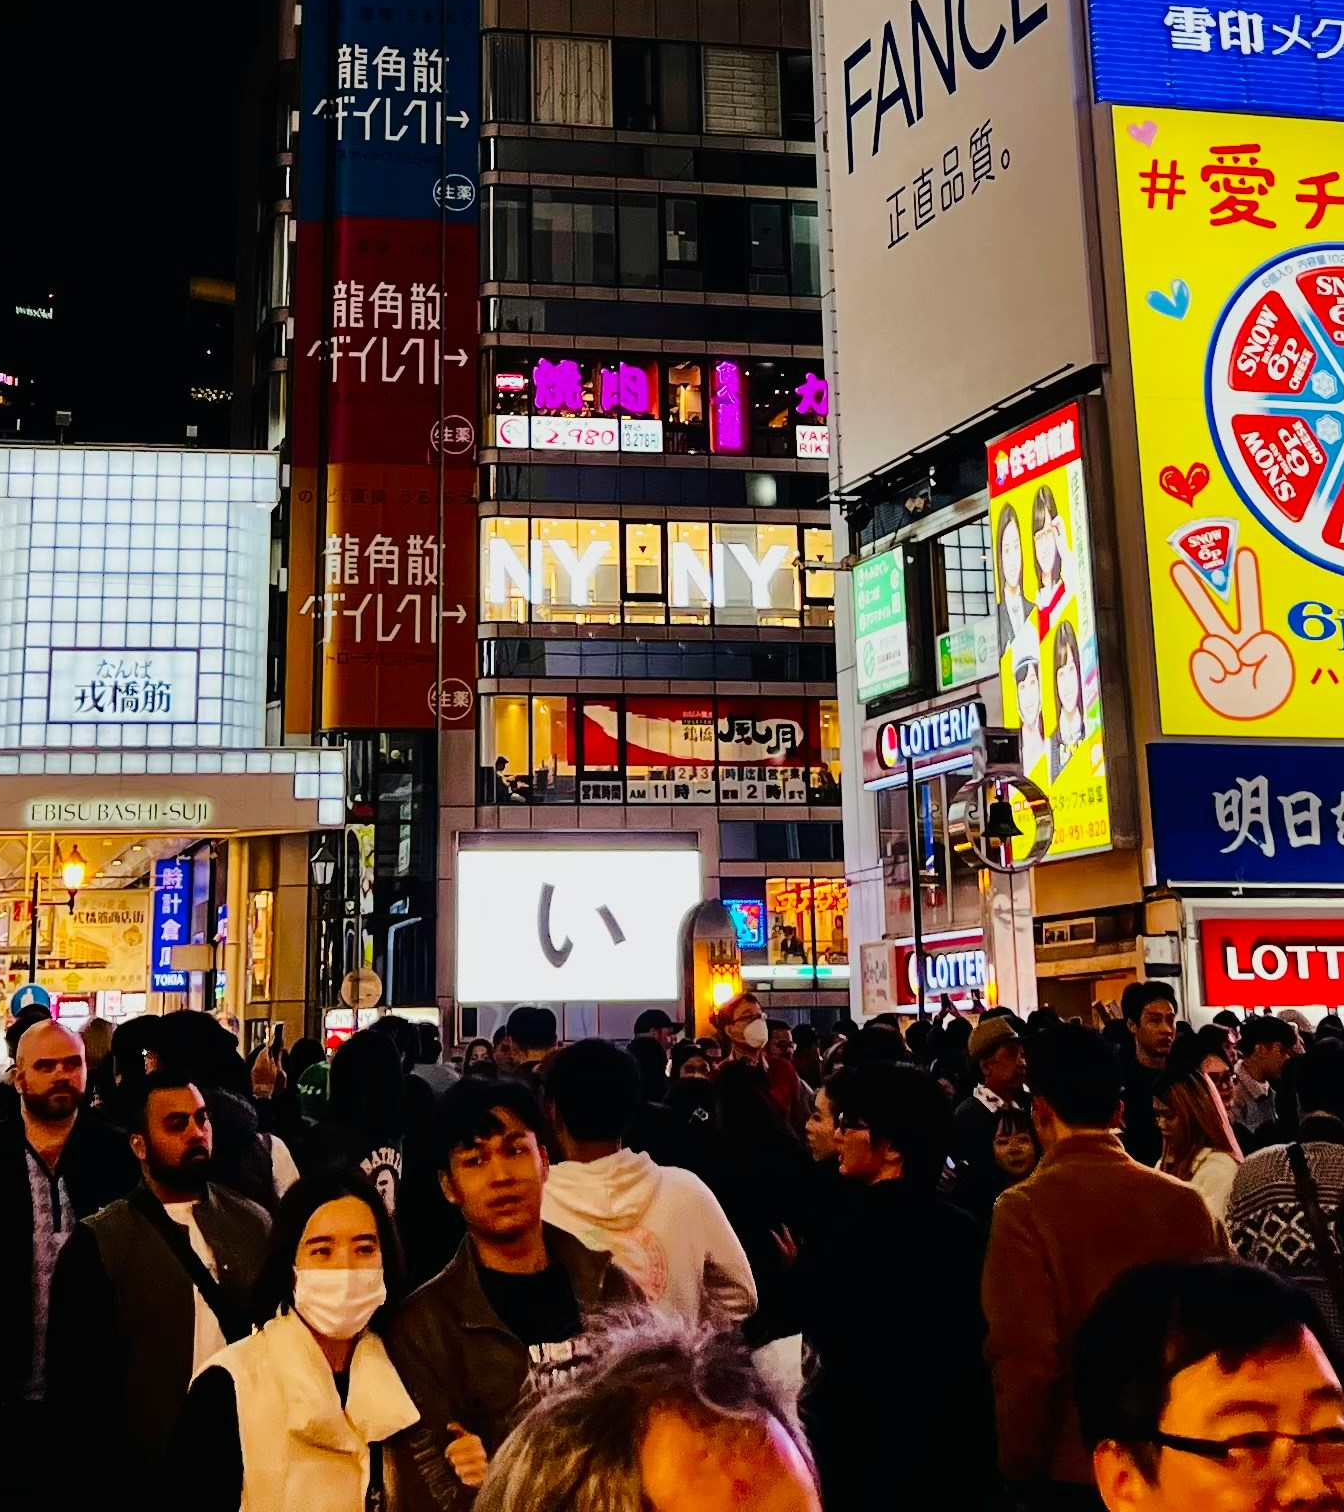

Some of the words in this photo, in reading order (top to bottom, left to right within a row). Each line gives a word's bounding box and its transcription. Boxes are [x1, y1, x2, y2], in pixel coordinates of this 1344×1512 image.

[337, 43, 450, 94] 龍角散
[886, 117, 1011, 250] 正直品質。
[331, 280, 449, 332] 龍角散
[1236, 303, 1281, 377] SNOW
[1267, 337, 1300, 381] 6P
[532, 357, 651, 414] 焼肉
[1288, 347, 1315, 391] CHEESE
[1239, 430, 1297, 504] SNOW
[321, 532, 446, 587] 龍角散
[488, 538, 612, 606] NY
[671, 541, 790, 609] NY
[97, 659, 153, 679] なんば
[74, 680, 173, 713] 戎橋筋
[717, 714, 797, 755] 風月
[899, 702, 981, 756] LOTTERIA
[30, 802, 93, 823] EBISU
[97, 802, 209, 824] BASHI-SUJI
[581, 784, 622, 800] 営業時間
[629, 790, 647, 800] AM
[536, 881, 628, 968] い
